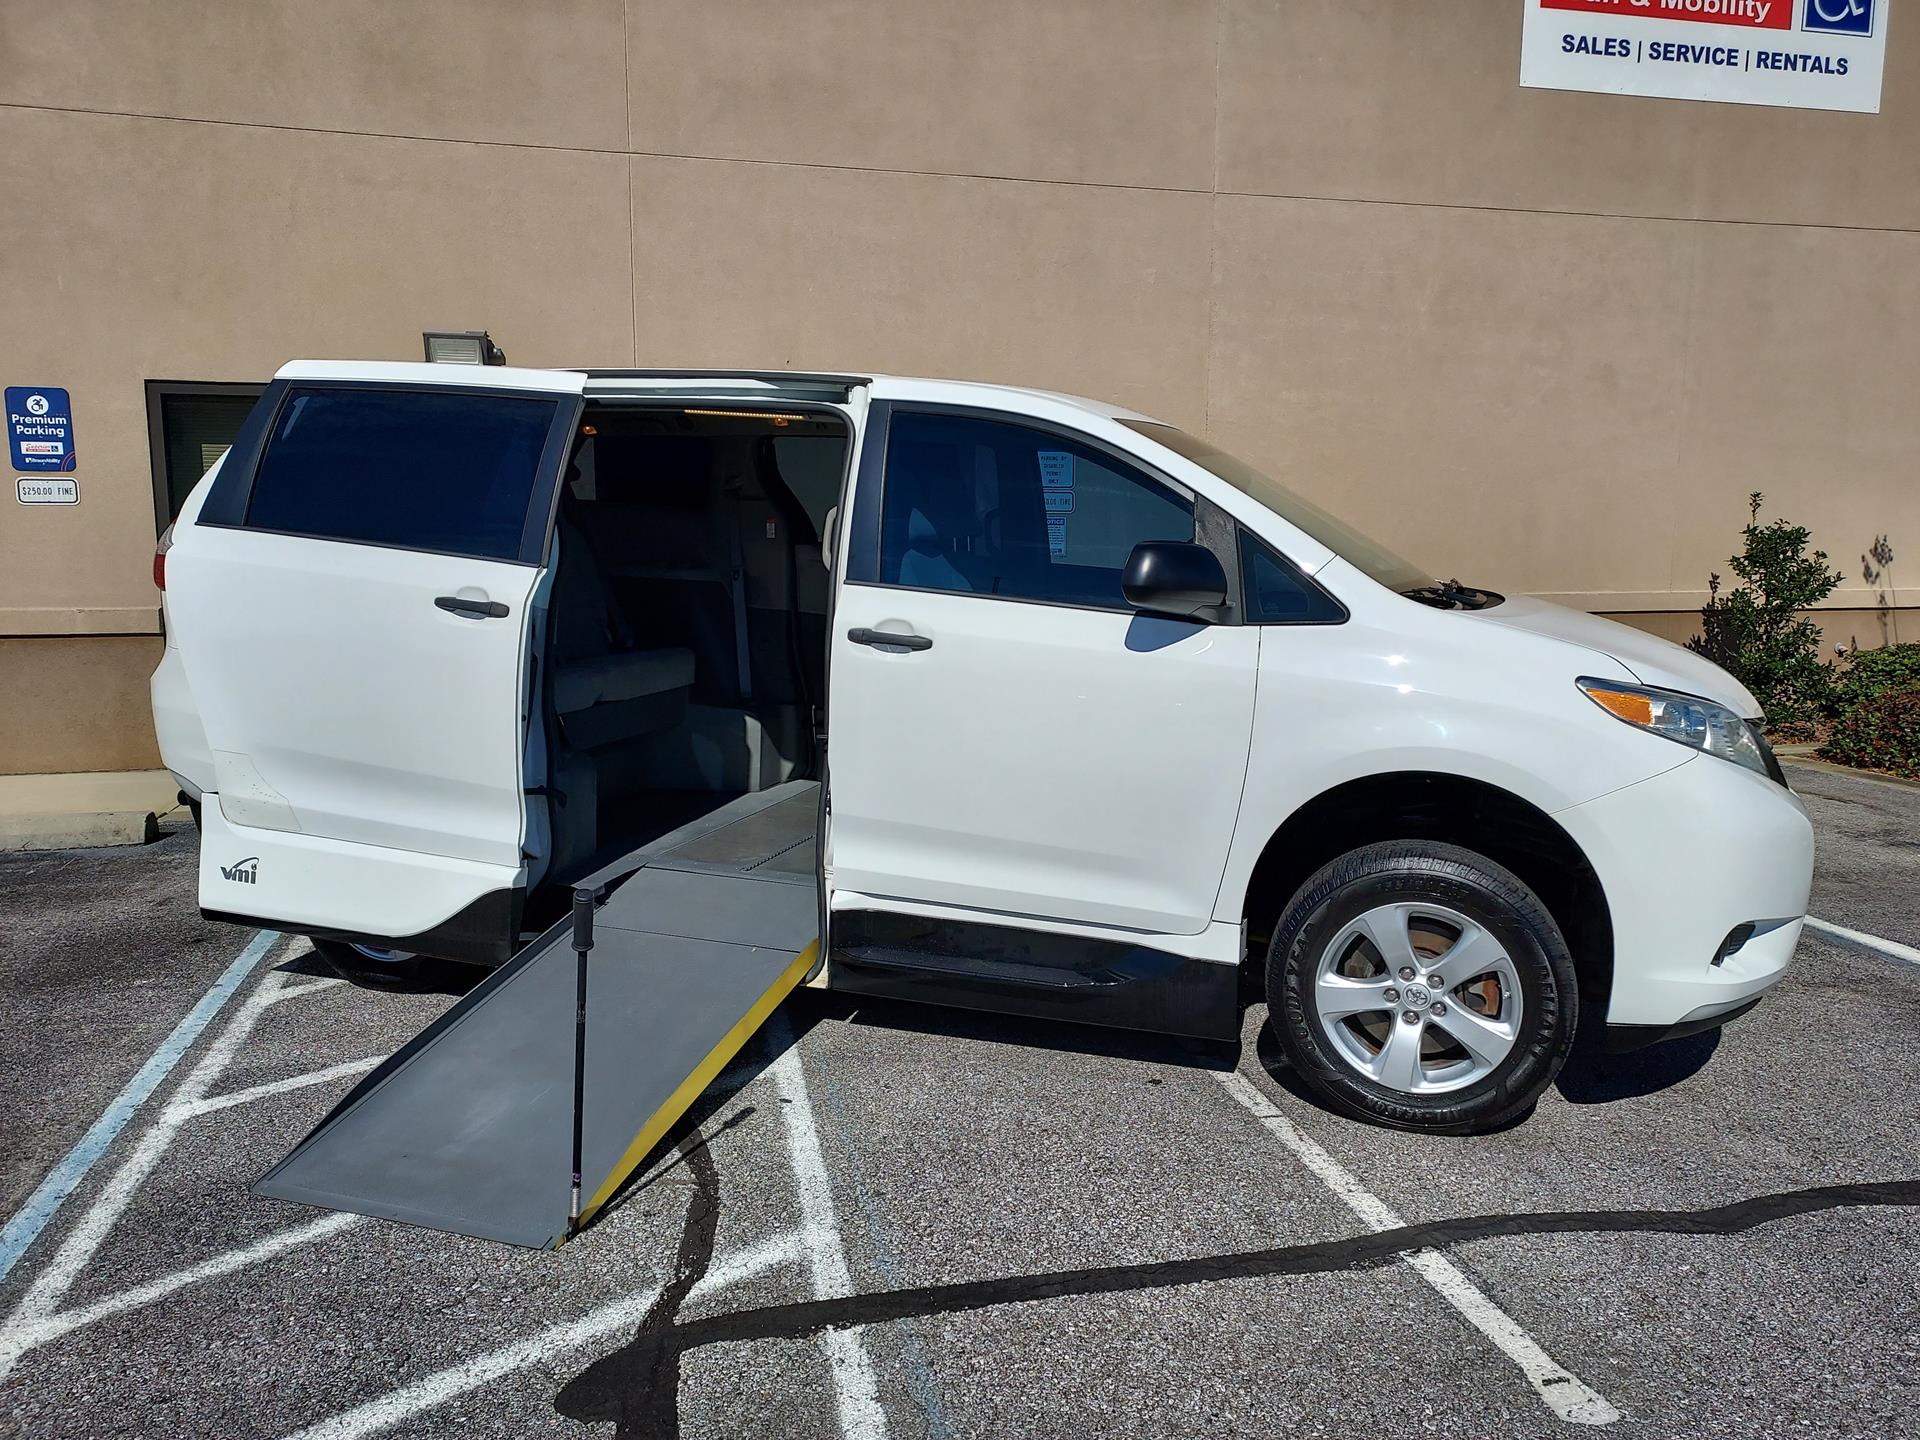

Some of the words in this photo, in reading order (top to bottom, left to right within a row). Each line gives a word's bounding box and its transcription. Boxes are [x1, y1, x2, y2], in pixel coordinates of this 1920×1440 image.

[1561, 34, 1631, 58] SALES
[1648, 42, 1739, 67] SERVICE
[1755, 51, 1849, 75] RENTALS
[11, 414, 67, 425] Premium
[16, 425, 65, 438] Parking
[22, 486, 53, 496] $250.00
[57, 487, 74, 496] FINE
